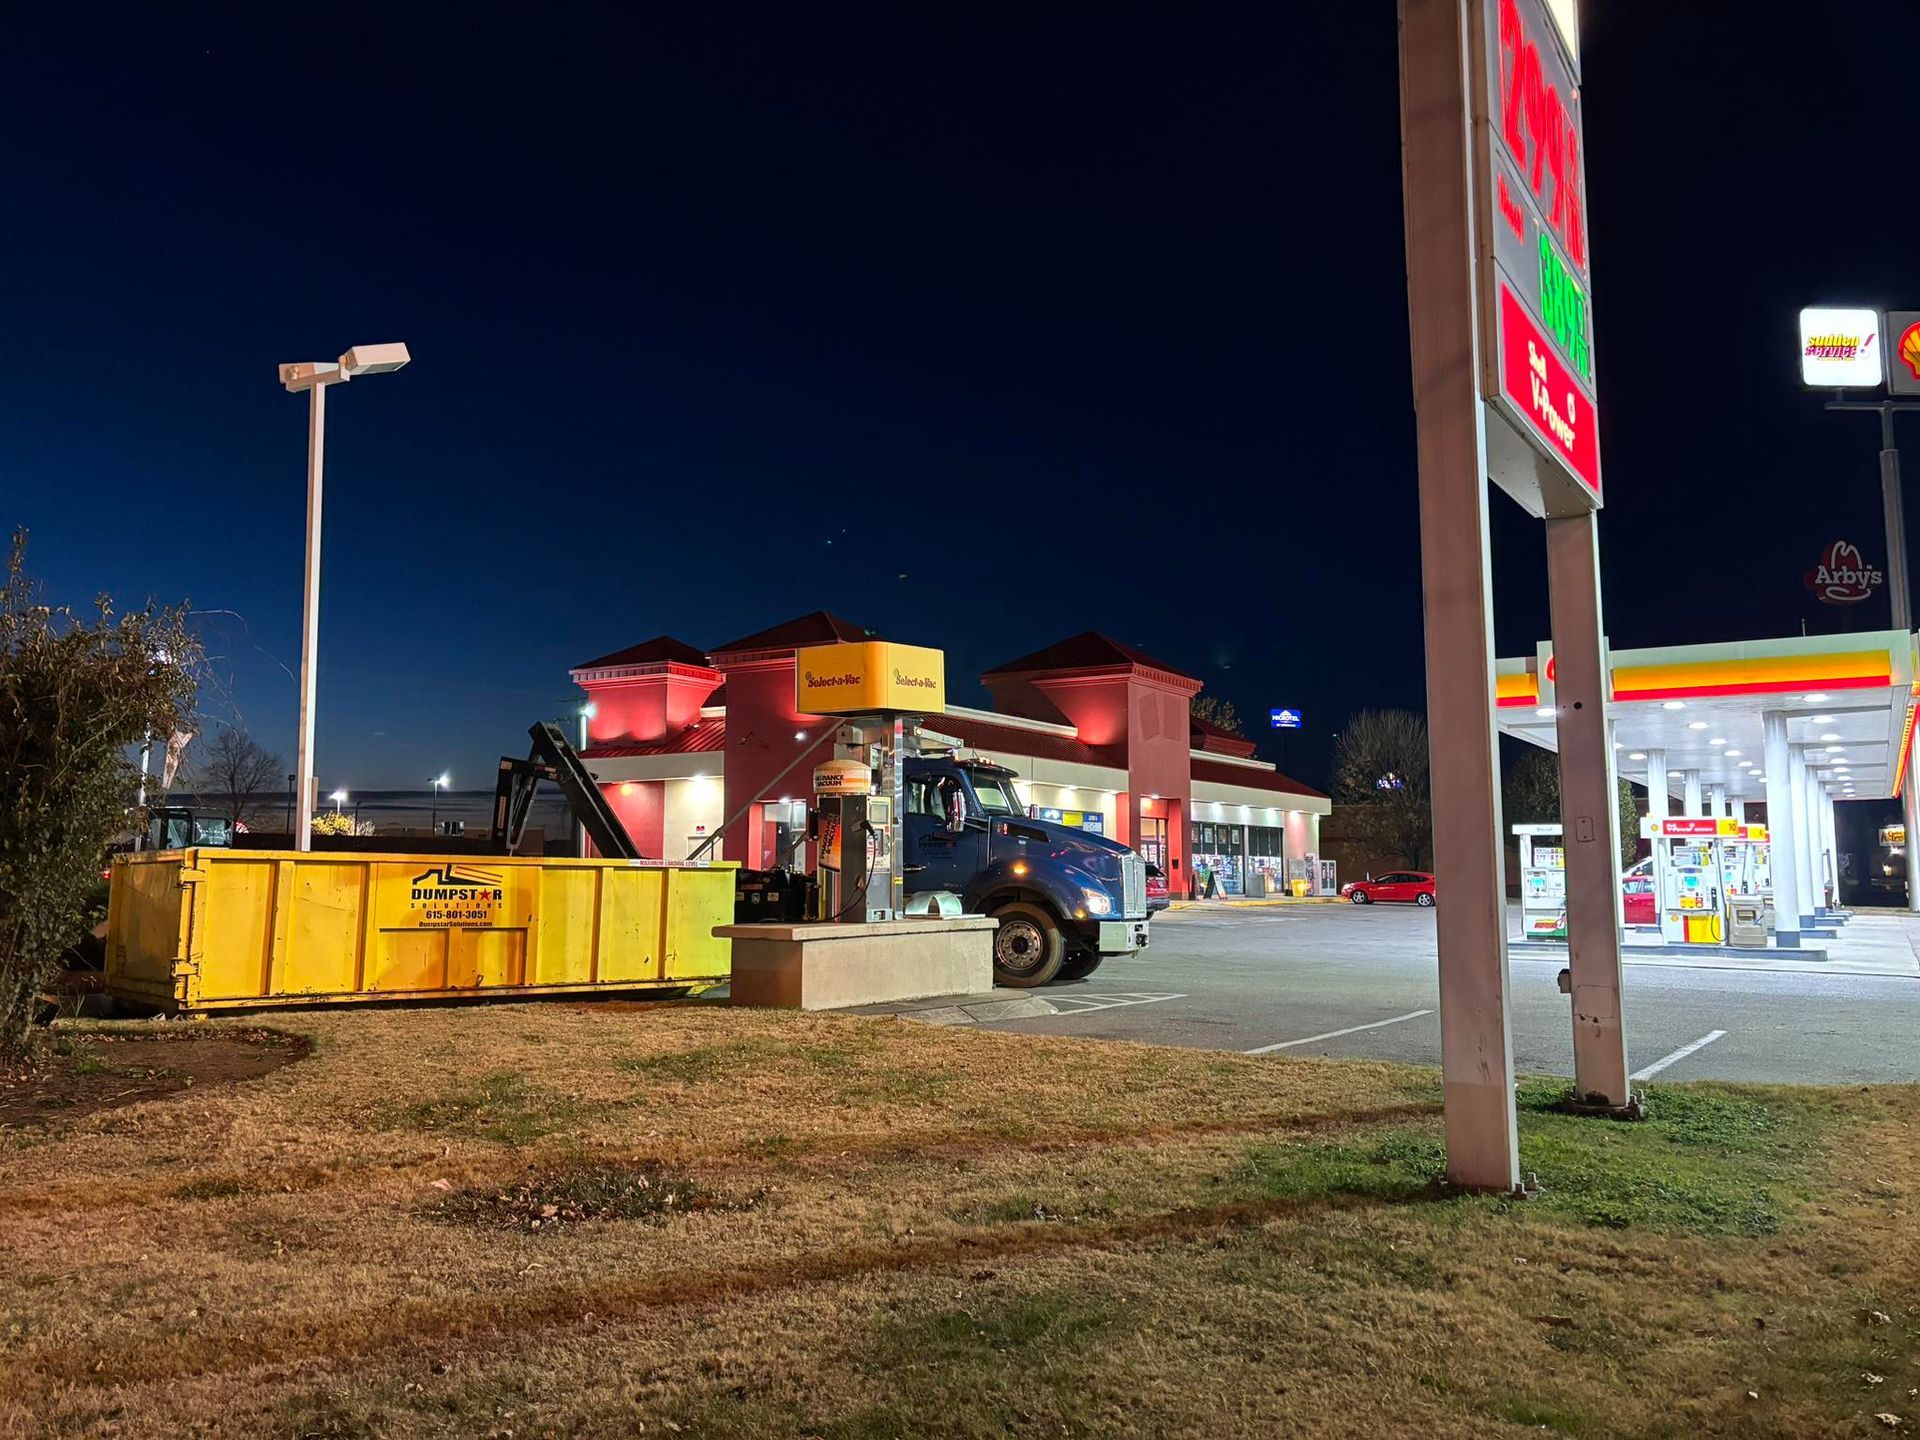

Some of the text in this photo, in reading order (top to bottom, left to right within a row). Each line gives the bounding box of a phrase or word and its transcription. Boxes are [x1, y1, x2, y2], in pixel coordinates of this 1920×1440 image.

[1502, 0, 1565, 231] 299
[1539, 233, 1576, 361] 389
[1808, 333, 1860, 347] sudden
[1805, 346, 1857, 357] service
[1528, 340, 1547, 383] Shell
[1530, 370, 1576, 452] V-Power
[1815, 565, 1883, 589] Arby's
[808, 674, 861, 688] Select-a-Vac
[895, 675, 937, 689] Select-a-Vac
[426, 910, 487, 919] 615-801-3051
